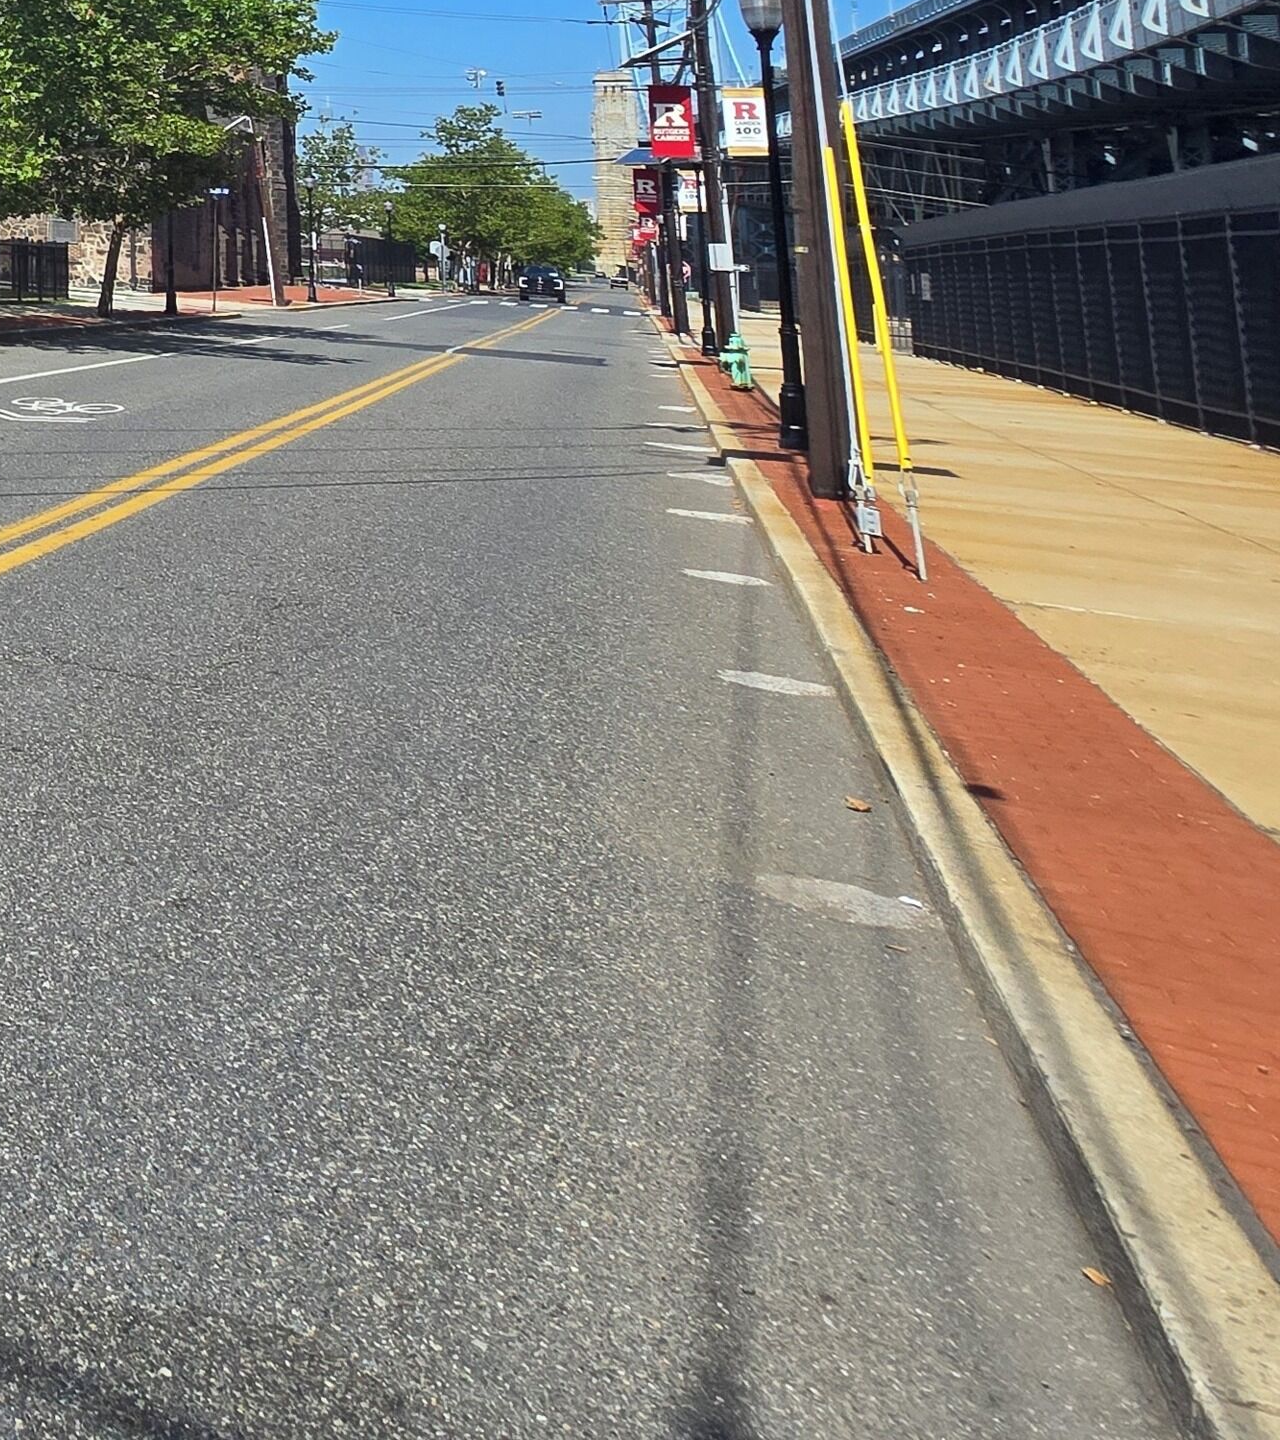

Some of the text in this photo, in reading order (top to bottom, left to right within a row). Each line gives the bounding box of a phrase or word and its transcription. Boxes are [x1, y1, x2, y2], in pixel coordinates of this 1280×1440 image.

[653, 103, 689, 127] R
[732, 102, 761, 120] R
[735, 127, 762, 135] 100
[635, 179, 657, 194] R
